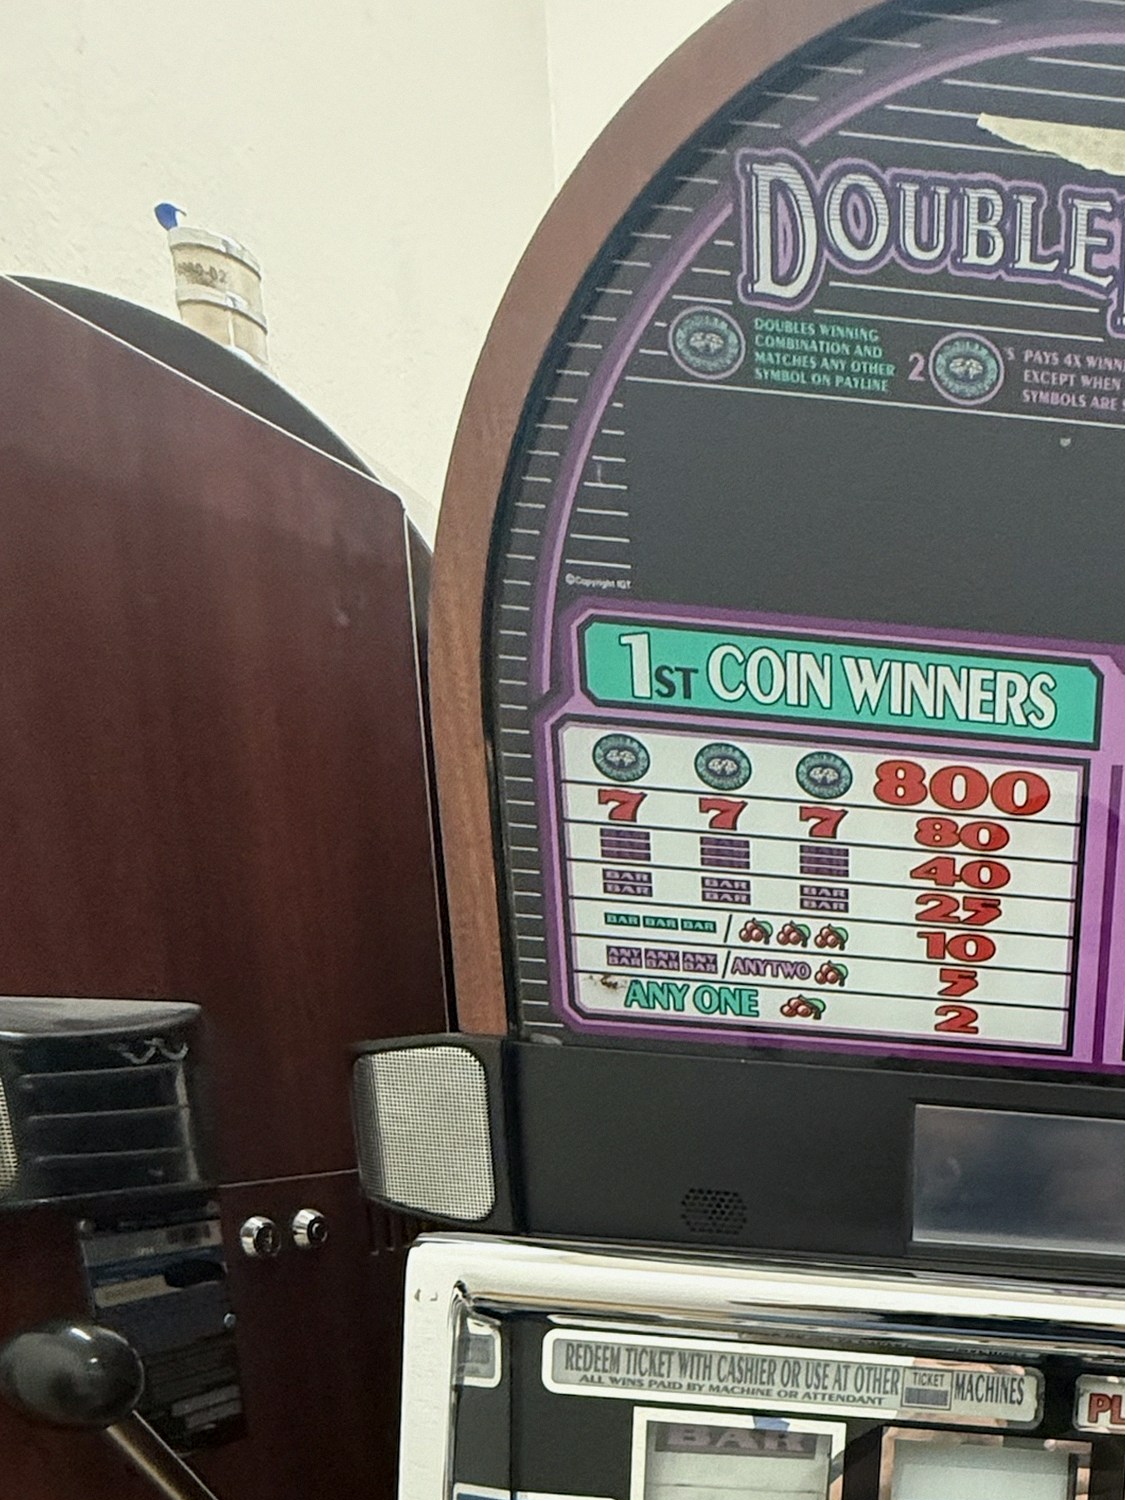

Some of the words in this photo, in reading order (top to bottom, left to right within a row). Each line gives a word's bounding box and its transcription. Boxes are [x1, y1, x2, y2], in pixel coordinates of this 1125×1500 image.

[755, 318, 815, 335] DOUBLES
[820, 325, 879, 341] WINNING
[755, 335, 849, 354] COMBINATION
[855, 345, 882, 358] AND
[1023, 349, 1059, 365] PAYS
[1064, 354, 1081, 368] 4X
[755, 352, 817, 369] MATCHES
[821, 358, 846, 371] ANY
[851, 361, 895, 376] OTHER
[908, 353, 925, 382] 2
[755, 369, 807, 384] SYMBOL
[835, 377, 888, 392] PAYLINE
[1024, 369, 1075, 386] EXCEPT
[1081, 375, 1121, 391] WHEN
[1023, 390, 1086, 408] SYMBOLS
[1091, 396, 1117, 410] ARE
[619, 631, 698, 700] 1ST
[706, 643, 832, 710] COIN
[841, 655, 1057, 729] WINNERS
[873, 759, 1050, 816] 800
[597, 789, 647, 823] 7
[698, 798, 747, 831] 7
[799, 806, 848, 839] 7
[914, 817, 1010, 852] 80
[909, 856, 1010, 891] 40
[915, 894, 1002, 927] 25
[917, 931, 996, 963] 10
[938, 970, 979, 998] 5
[624, 980, 690, 1011] ANY
[693, 985, 759, 1017] ONE
[934, 1004, 979, 1034] 2
[565, 1342, 620, 1374] REDEEM
[625, 1346, 674, 1378] TICKET
[679, 1350, 712, 1381] WITH
[717, 1354, 776, 1387] CASHIER
[780, 1358, 800, 1388] OR
[806, 1361, 828, 1390] USE
[834, 1364, 851, 1391] AT
[854, 1365, 900, 1395] OTHER
[608, 1376, 644, 1388] WINS
[709, 1384, 773, 1397] MACHINE
[802, 1391, 885, 1406] ATTENDANT
[913, 1371, 945, 1387] TICKET
[954, 1372, 1025, 1405] MACHINES
